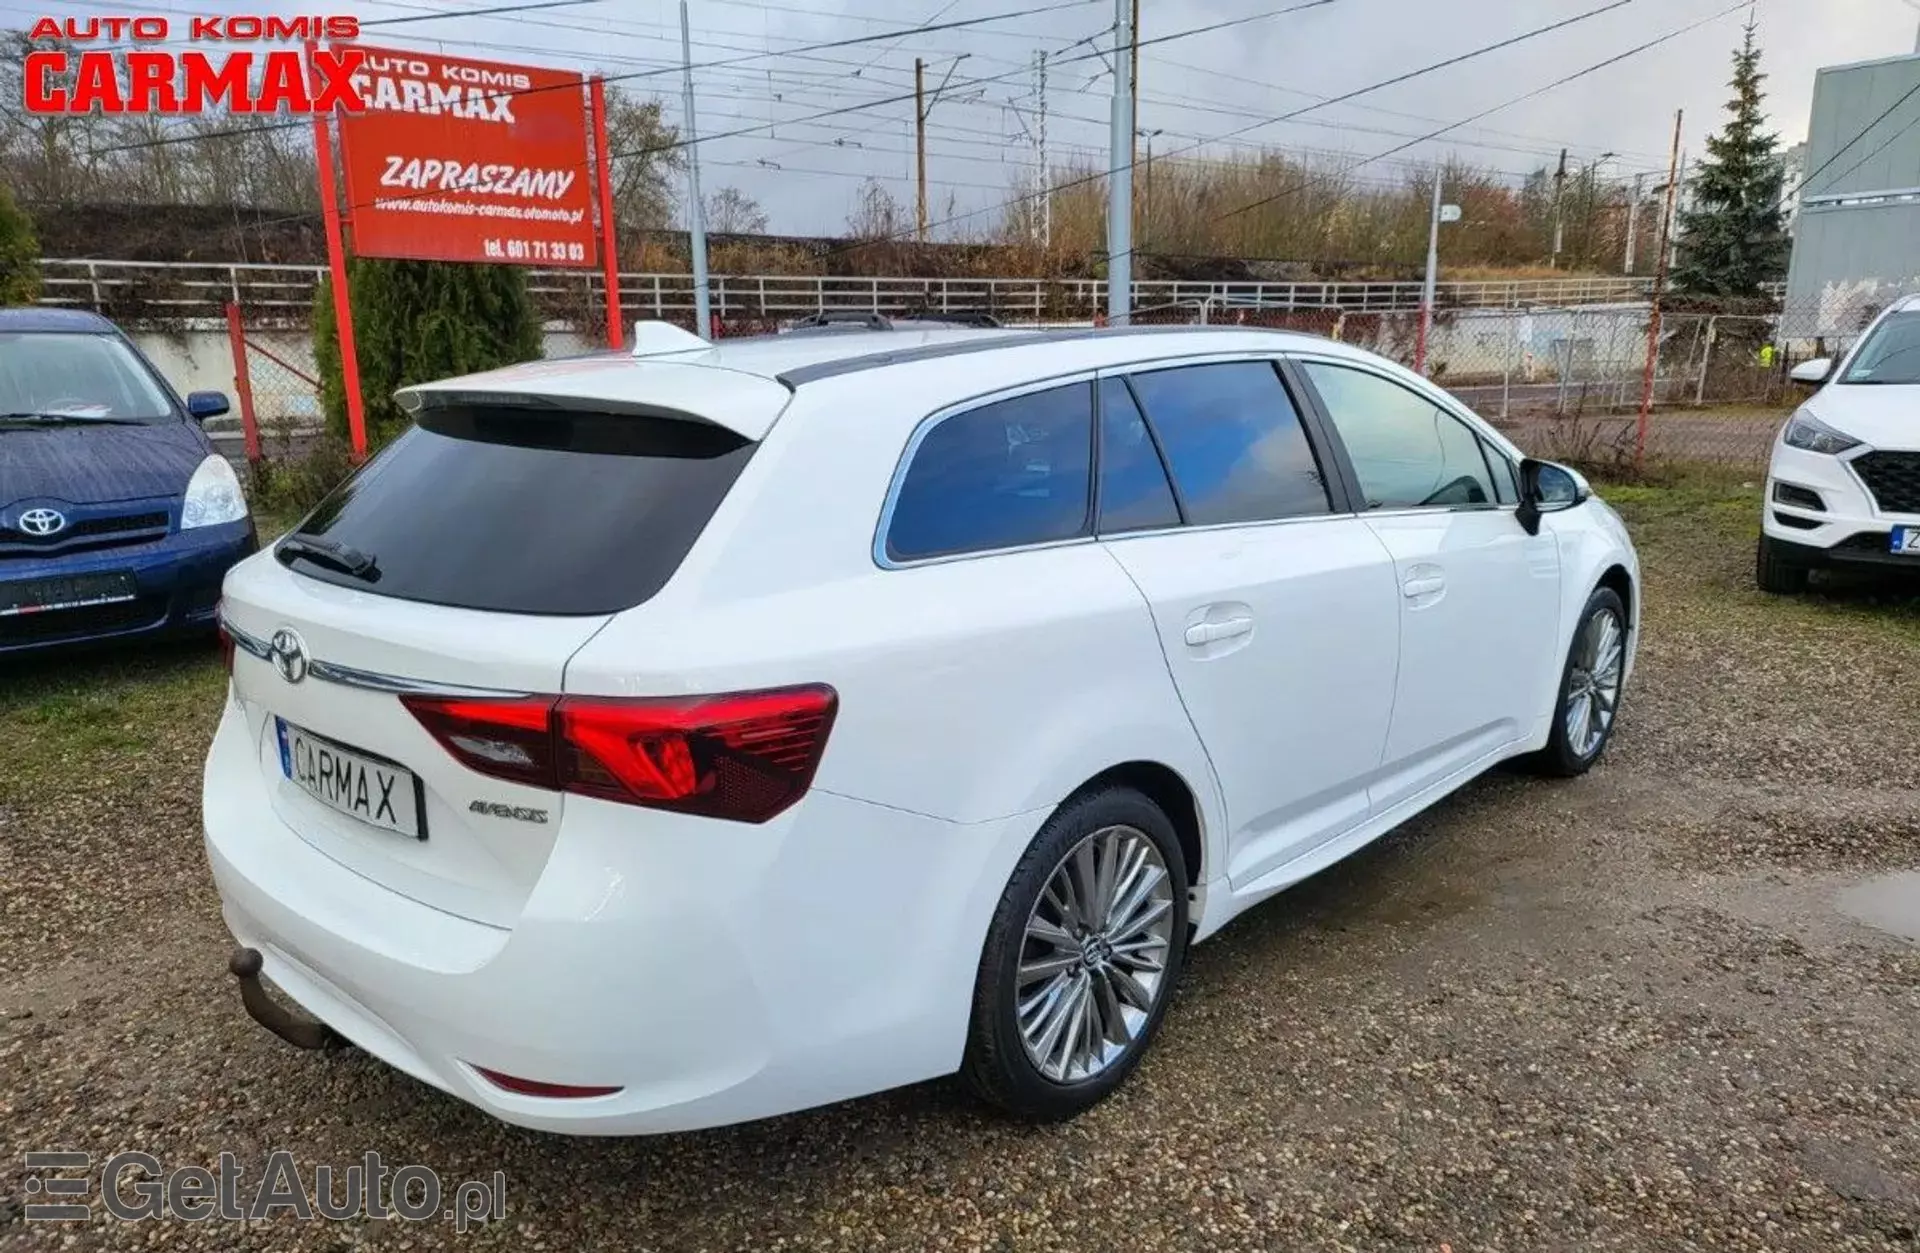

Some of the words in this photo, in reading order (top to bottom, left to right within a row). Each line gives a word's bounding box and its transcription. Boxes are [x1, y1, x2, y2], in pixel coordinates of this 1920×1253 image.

[441, 65, 531, 89] KOMIS
[380, 156, 575, 199] ZAPRASZAMY
[484, 239, 505, 258] tel.
[507, 240, 530, 259] 601
[533, 242, 548, 259] 71
[550, 242, 566, 260] 33
[568, 243, 584, 261] 03
[294, 737, 397, 824] CARMAX
